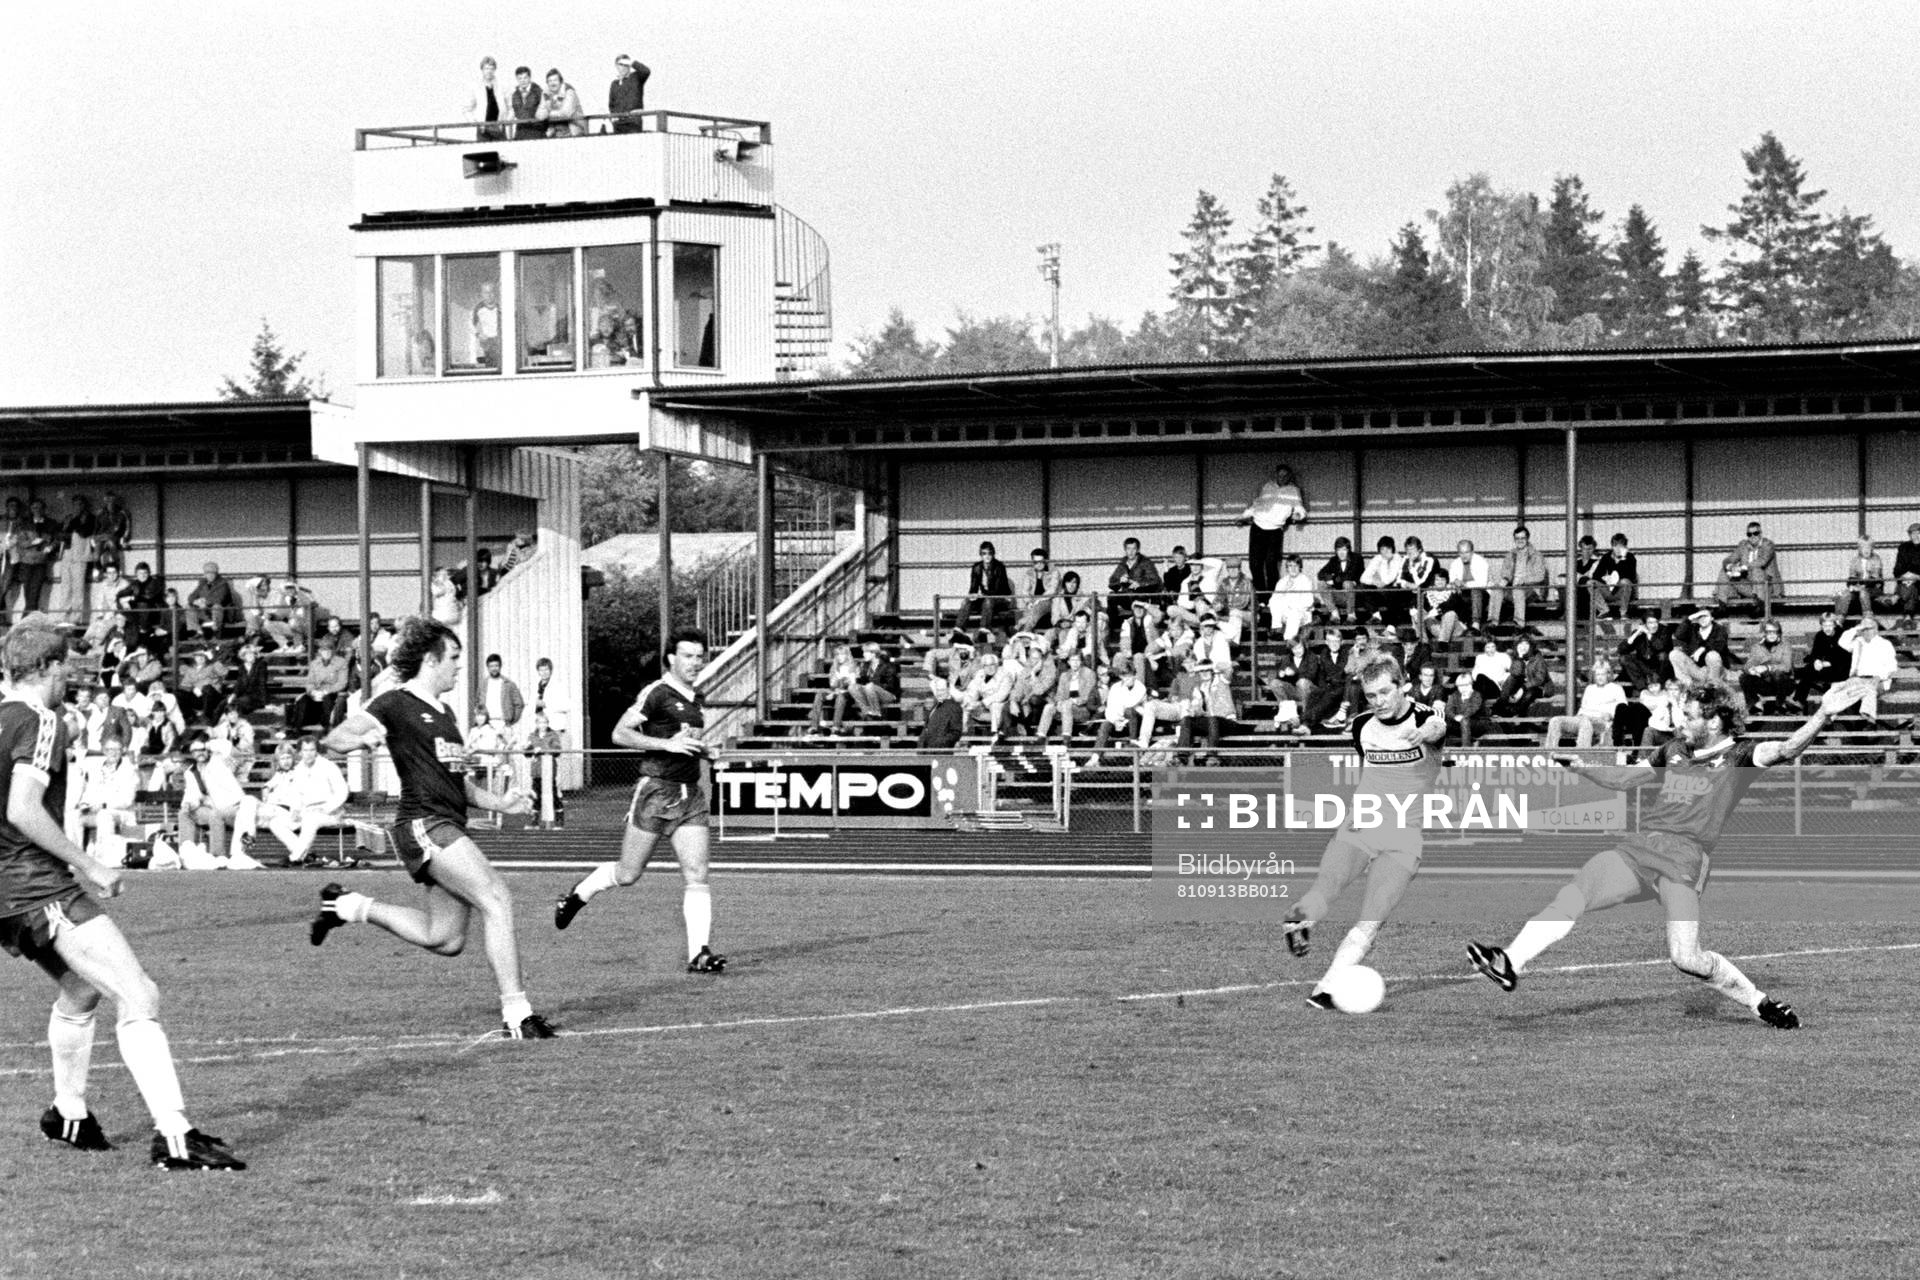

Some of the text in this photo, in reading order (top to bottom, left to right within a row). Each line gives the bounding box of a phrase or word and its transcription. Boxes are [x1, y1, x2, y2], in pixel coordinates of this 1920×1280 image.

[1434, 754, 1579, 786] ANDERSSON
[715, 772, 926, 809] TEMPO
[1540, 810, 1616, 826] TOLLARP
